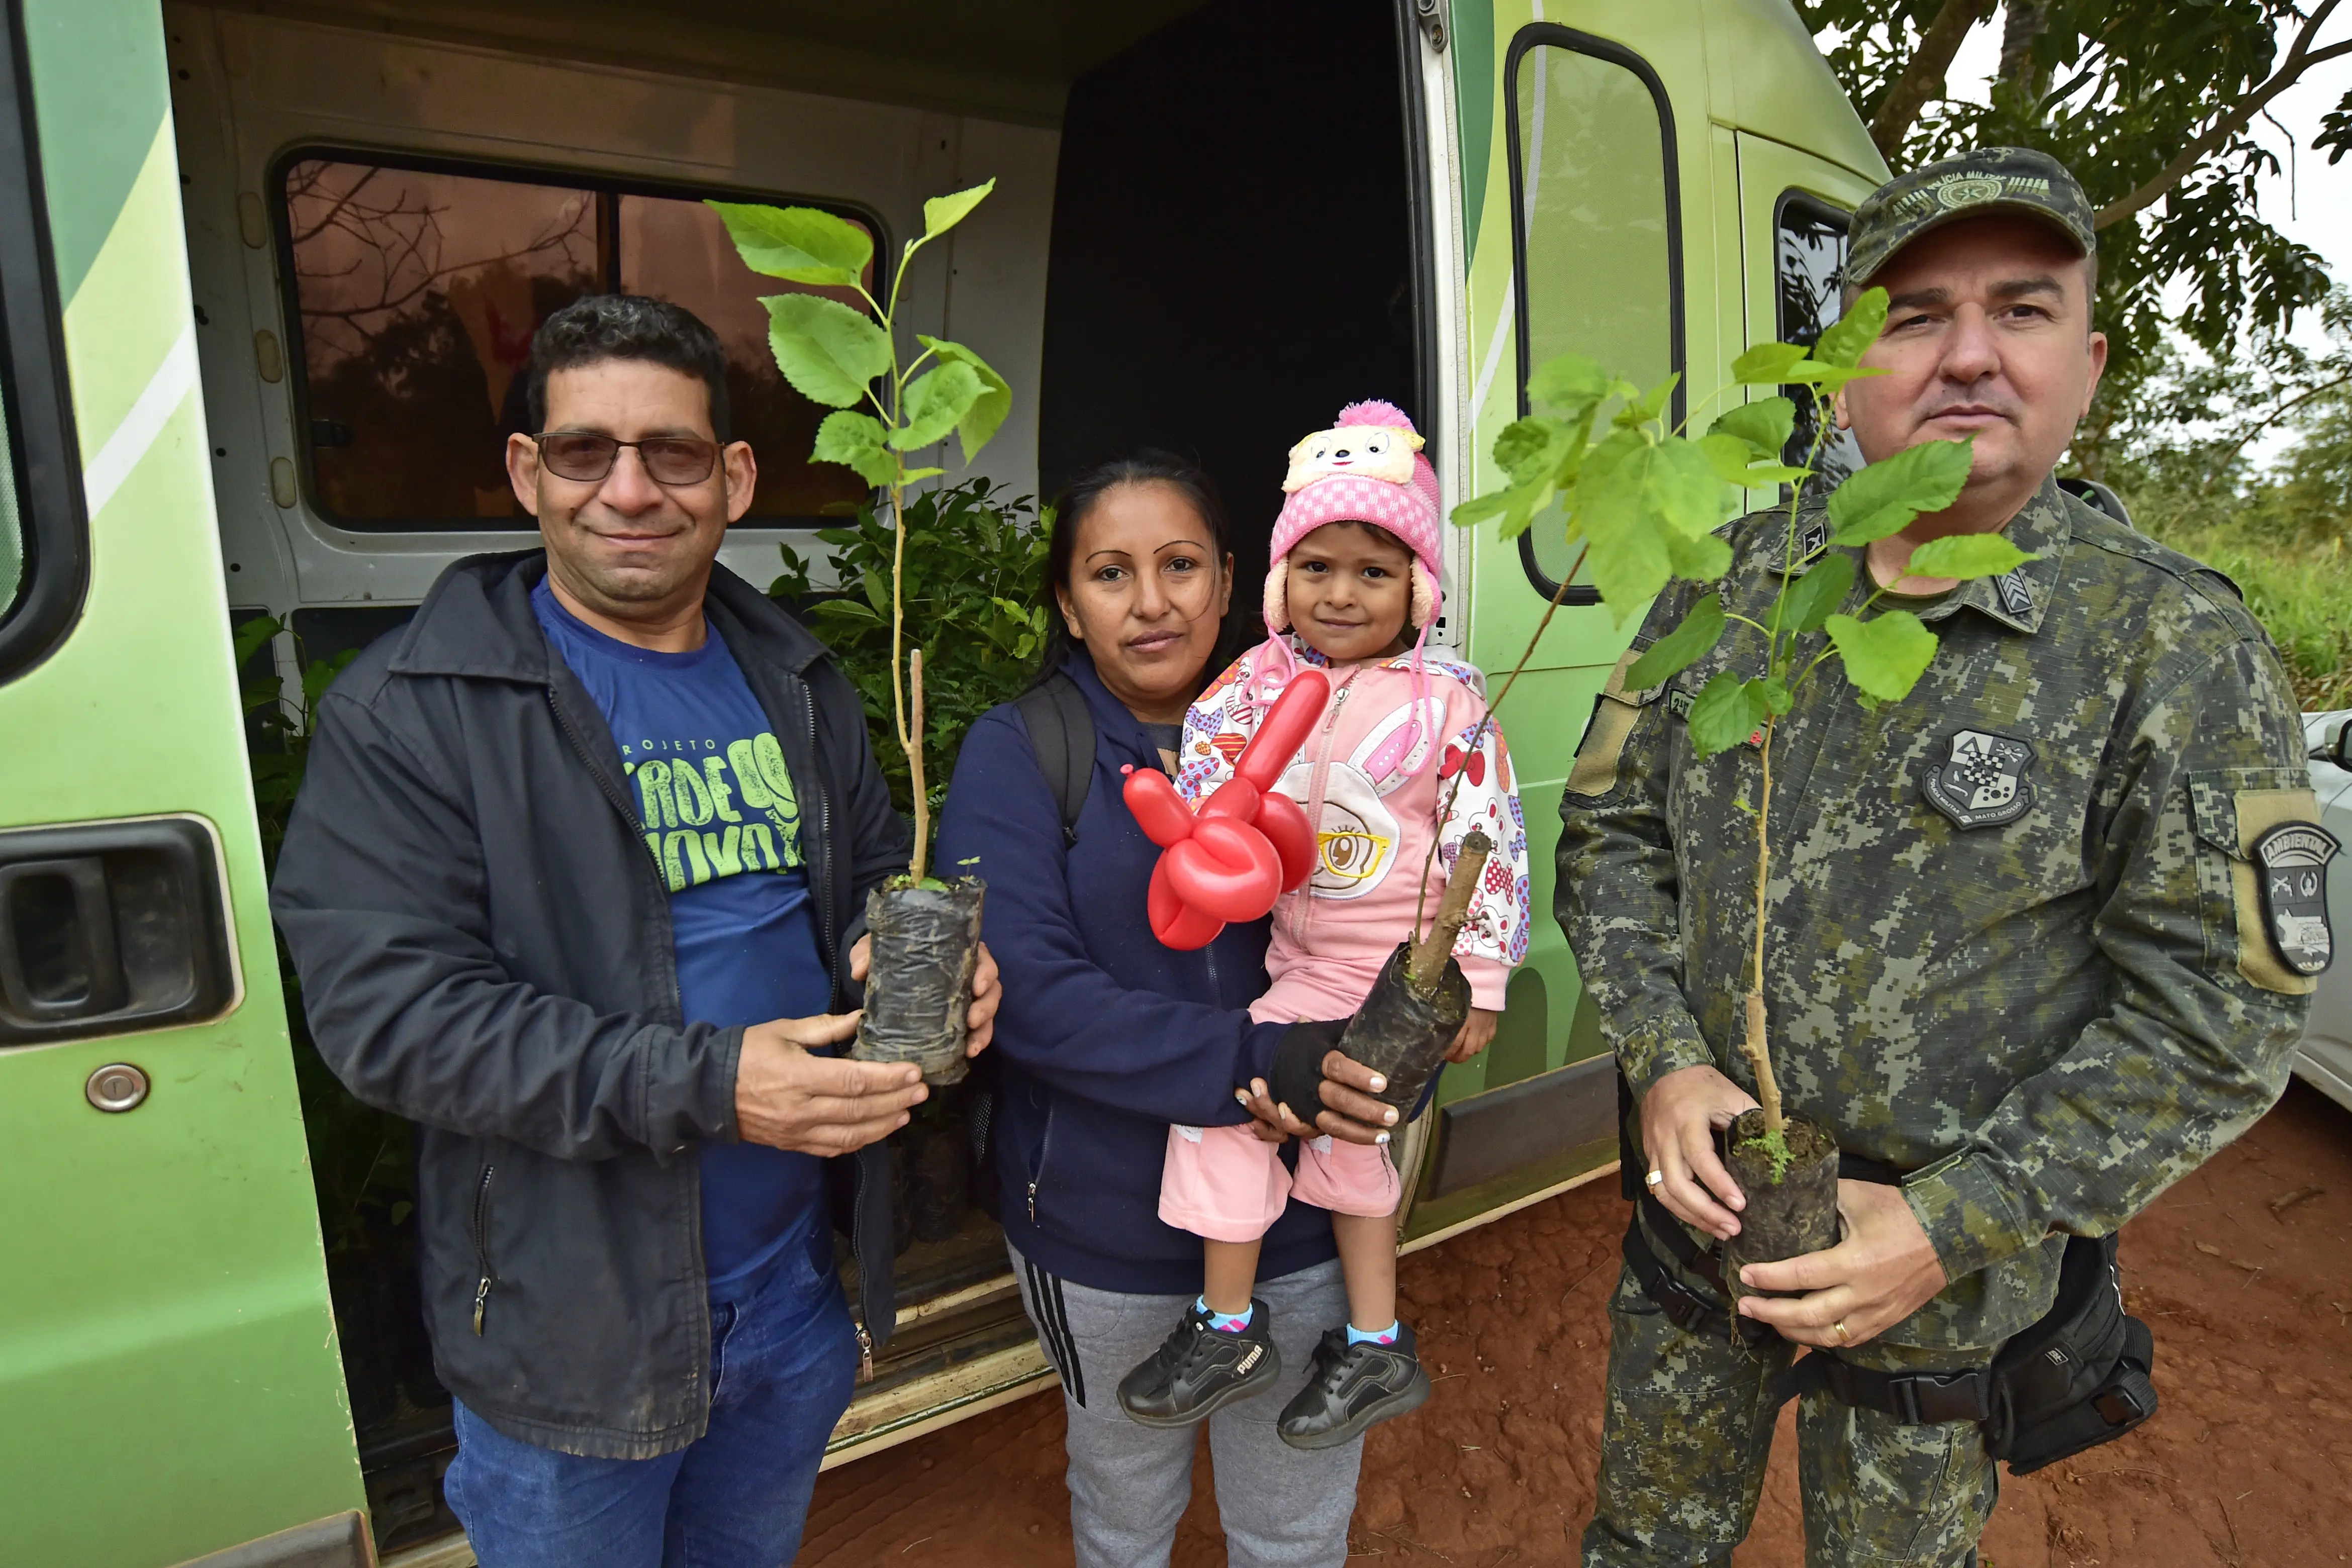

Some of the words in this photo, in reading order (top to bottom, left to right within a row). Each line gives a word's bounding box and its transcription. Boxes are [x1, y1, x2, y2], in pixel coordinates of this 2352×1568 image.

[622, 739, 716, 755] ROJETO
[623, 756, 743, 829] RDE
[1974, 812, 1997, 820] MATO
[1997, 801, 2021, 816] GROSSO
[2265, 833, 2327, 861] AMBIENTAL
[1237, 1344, 1263, 1375] PUMA
